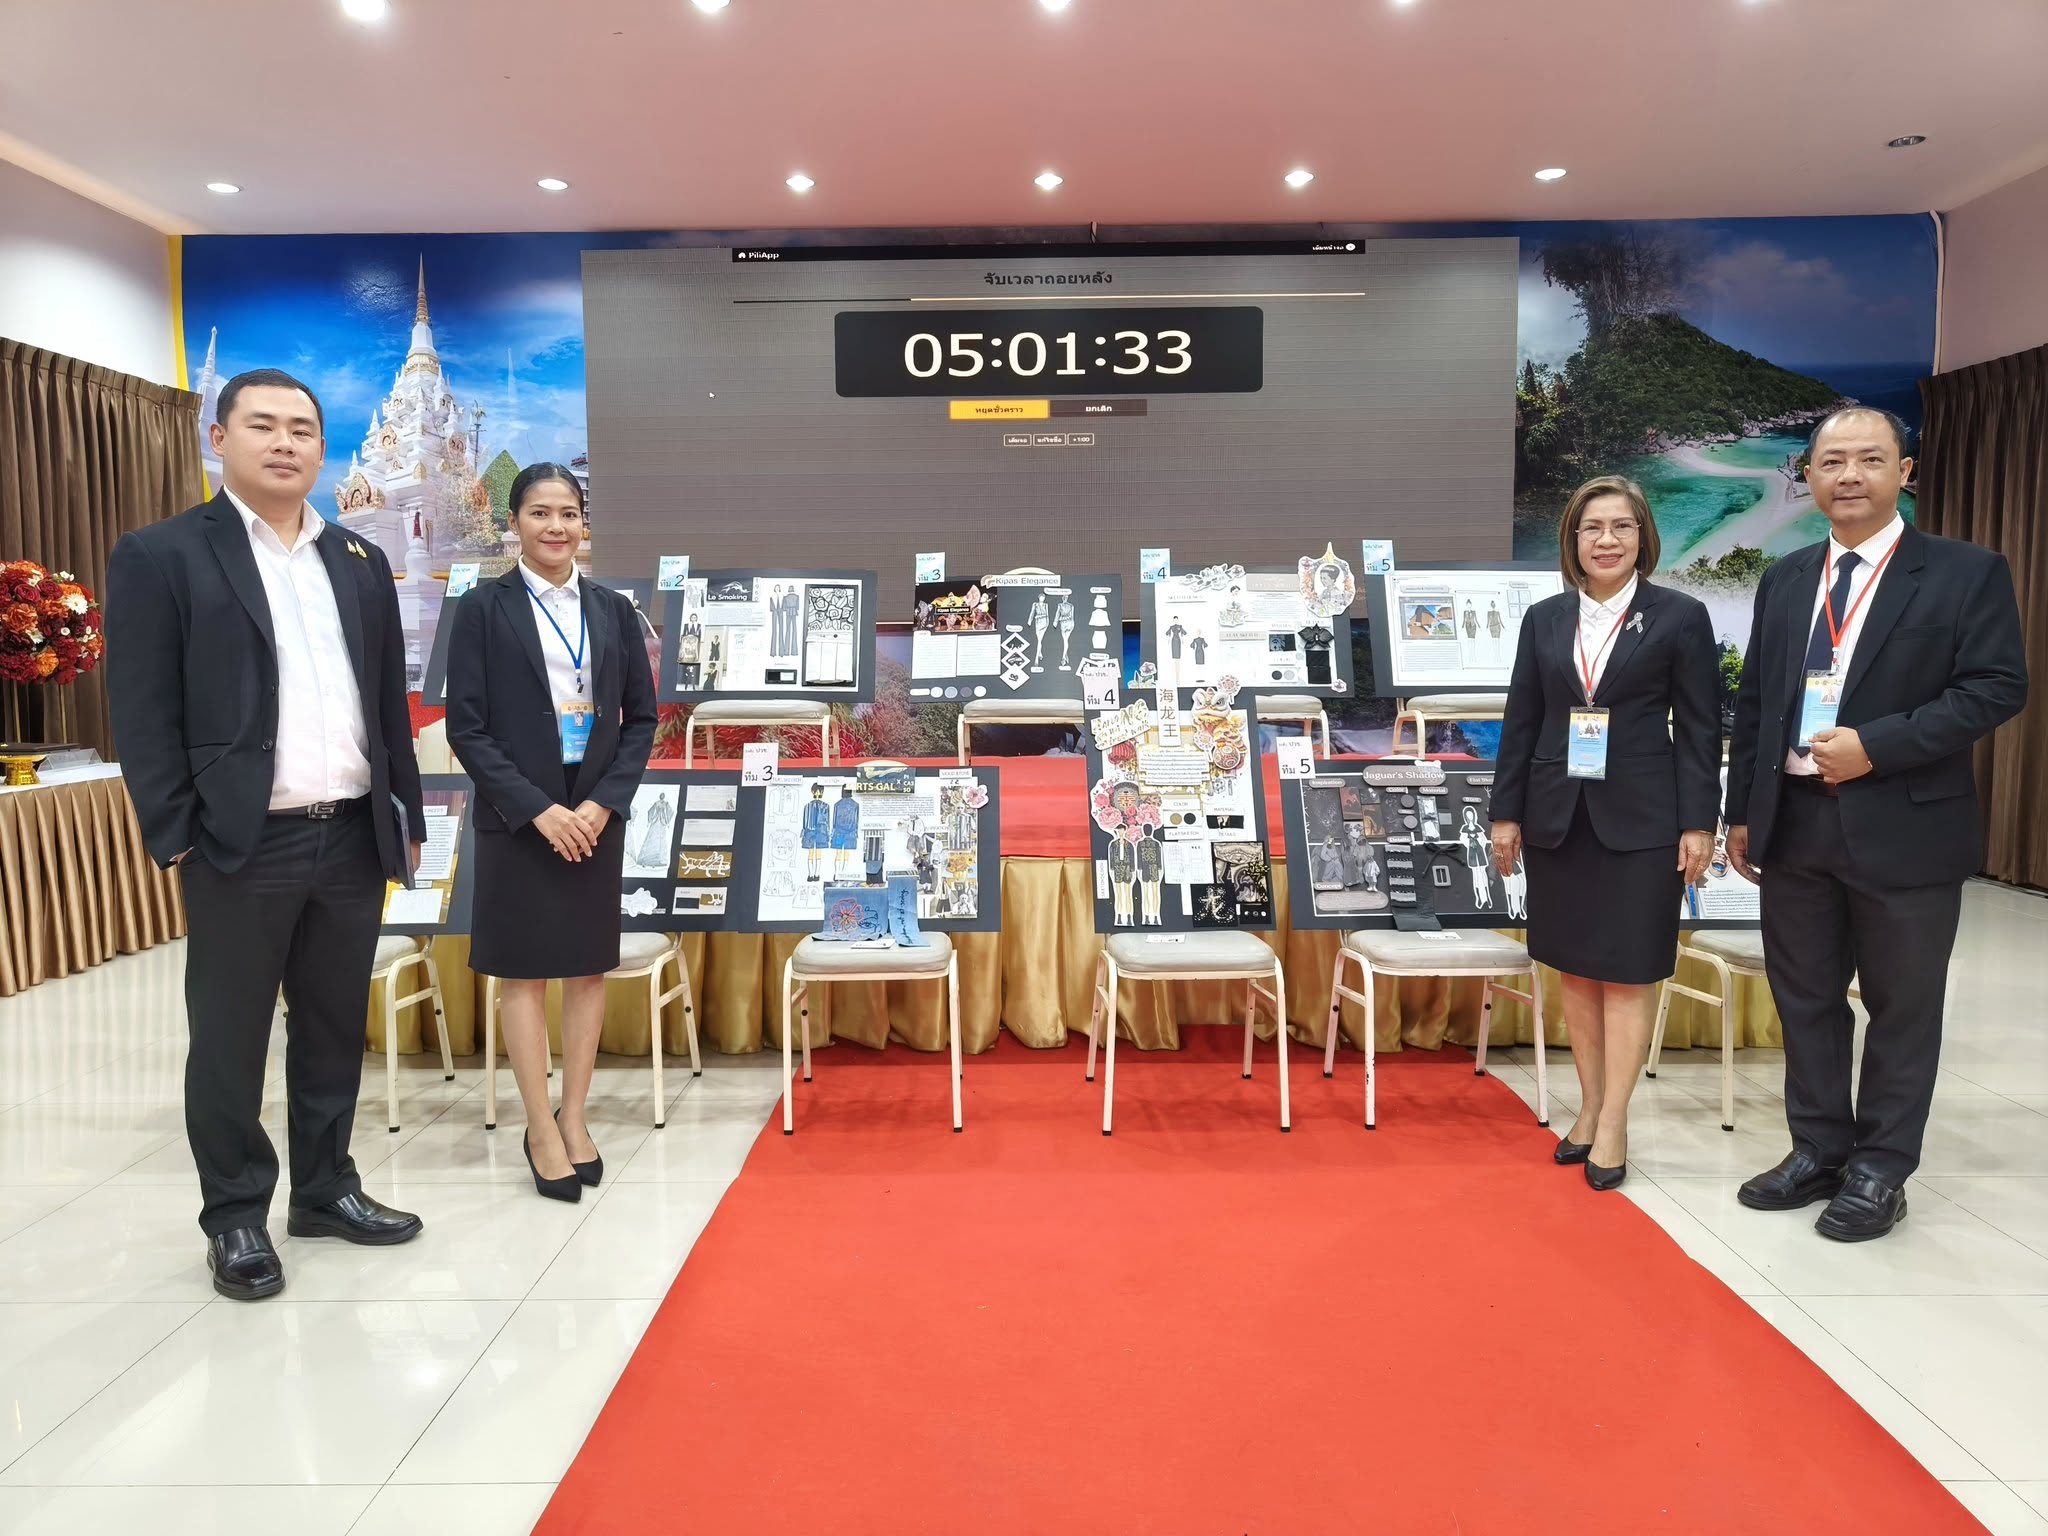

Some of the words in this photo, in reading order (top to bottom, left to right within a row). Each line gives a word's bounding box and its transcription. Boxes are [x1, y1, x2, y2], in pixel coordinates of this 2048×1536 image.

[748, 251, 780, 260] PiliApp
[983, 271, 1113, 285] จับเวลาถอยหลัง
[904, 329, 1193, 378] 05:01:33
[975, 404, 1024, 415] หยุดชั่วคราว
[1381, 558, 1391, 571] 5
[932, 569, 941, 581] 3
[1157, 566, 1167, 579] 4
[674, 574, 685, 587] 2
[995, 577, 1019, 585] Kipas
[1021, 577, 1059, 586] Elegance
[718, 593, 748, 602] Smoking
[1087, 694, 1100, 704] ทีม
[1104, 689, 1116, 705] 4
[1281, 764, 1295, 774] ทีม
[1300, 758, 1311, 774] 5
[744, 771, 758, 782] ทีม
[762, 765, 773, 782] 3
[1363, 771, 1404, 781] Jaguar's
[1405, 772, 1445, 780] Shadow
